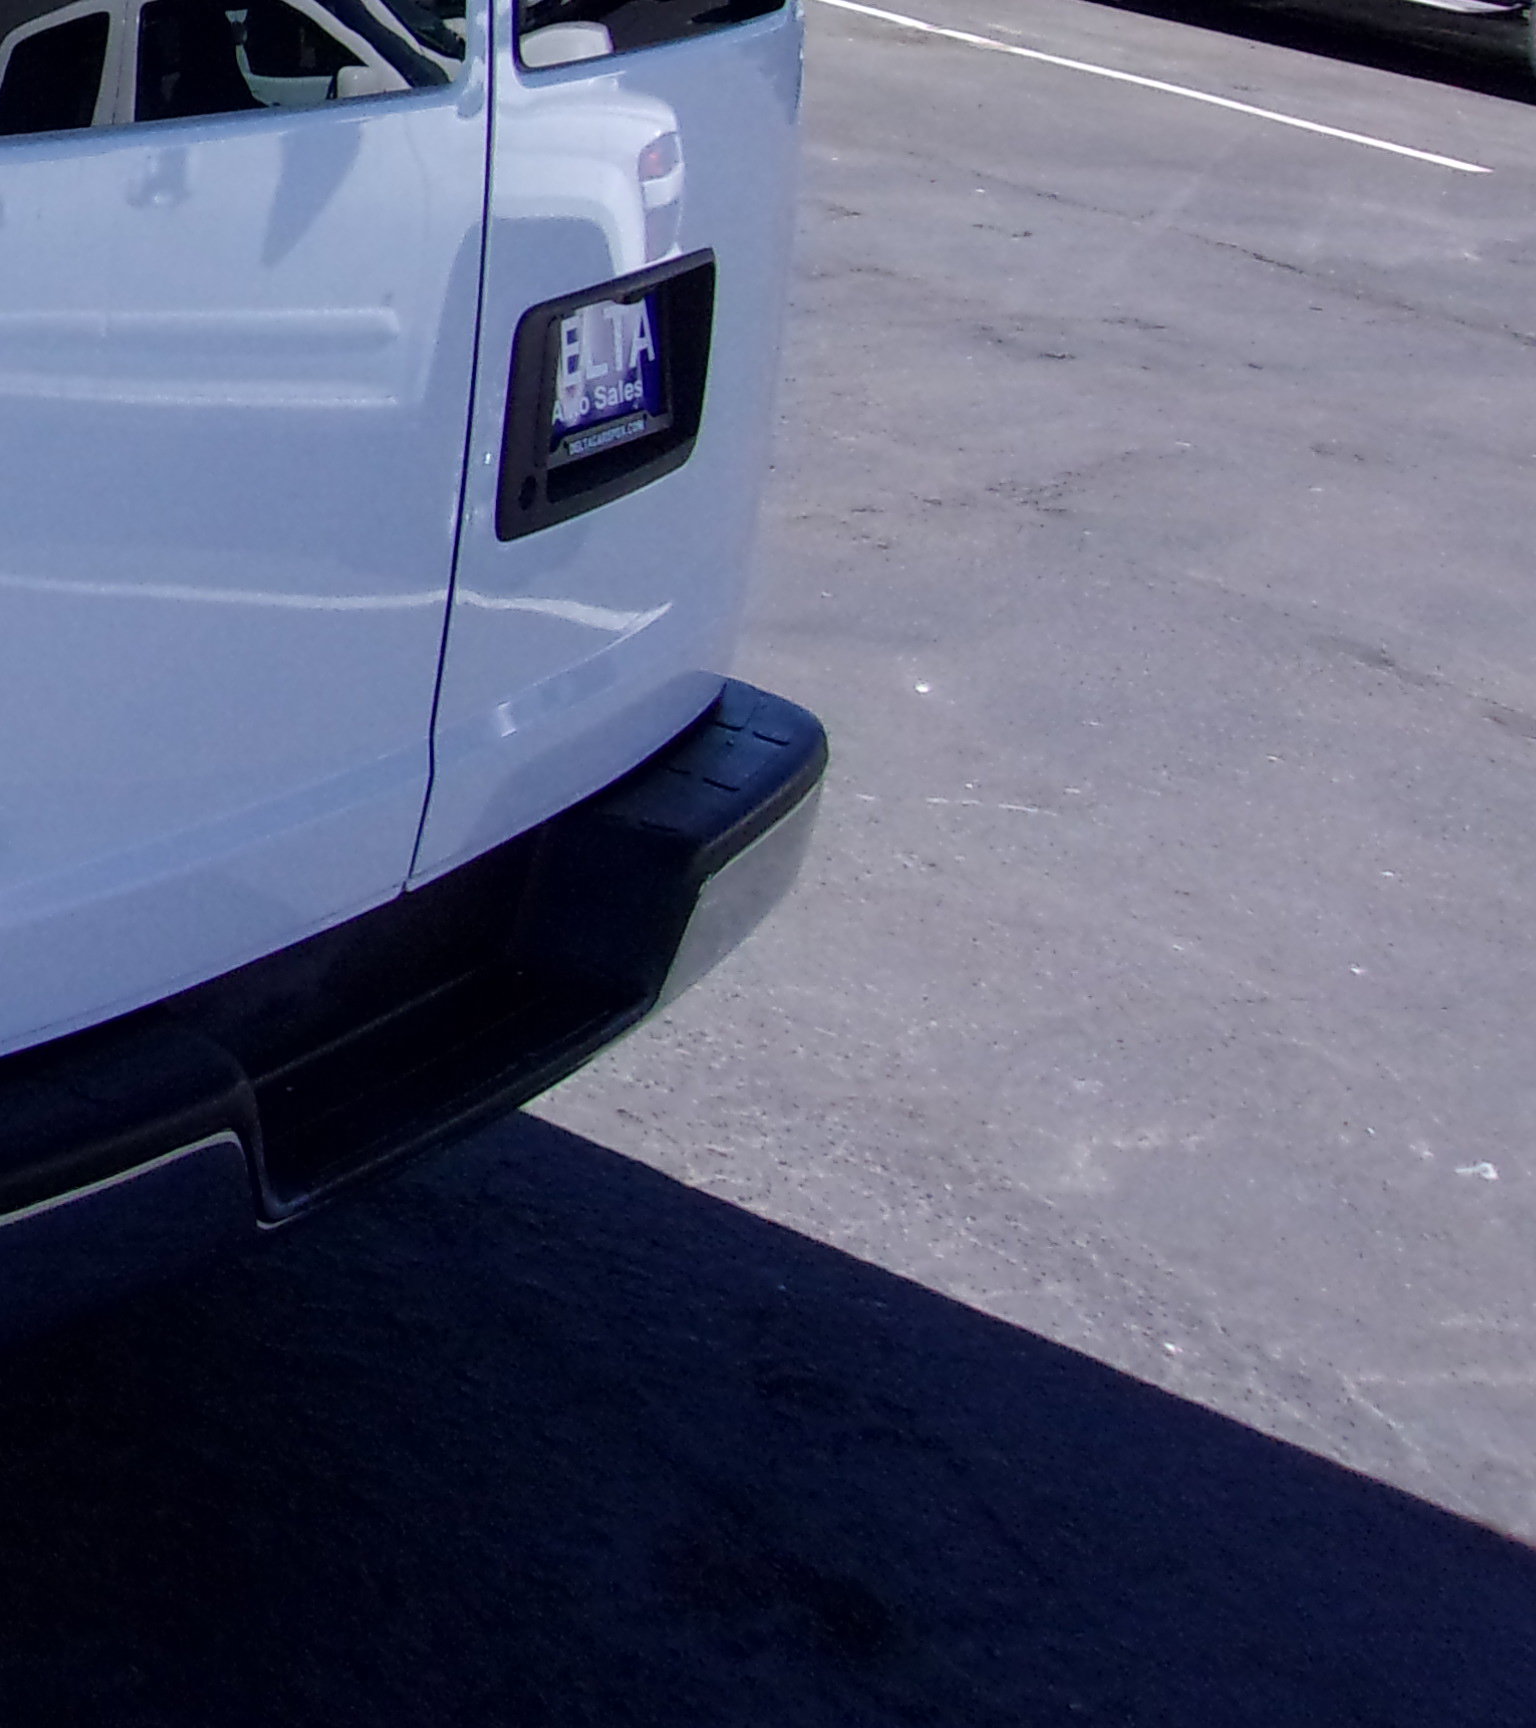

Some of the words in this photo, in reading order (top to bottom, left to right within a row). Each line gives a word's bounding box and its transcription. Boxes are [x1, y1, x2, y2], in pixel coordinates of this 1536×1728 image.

[561, 298, 656, 388] ELTA
[552, 395, 590, 426] Ao
[594, 379, 645, 410] Sales
